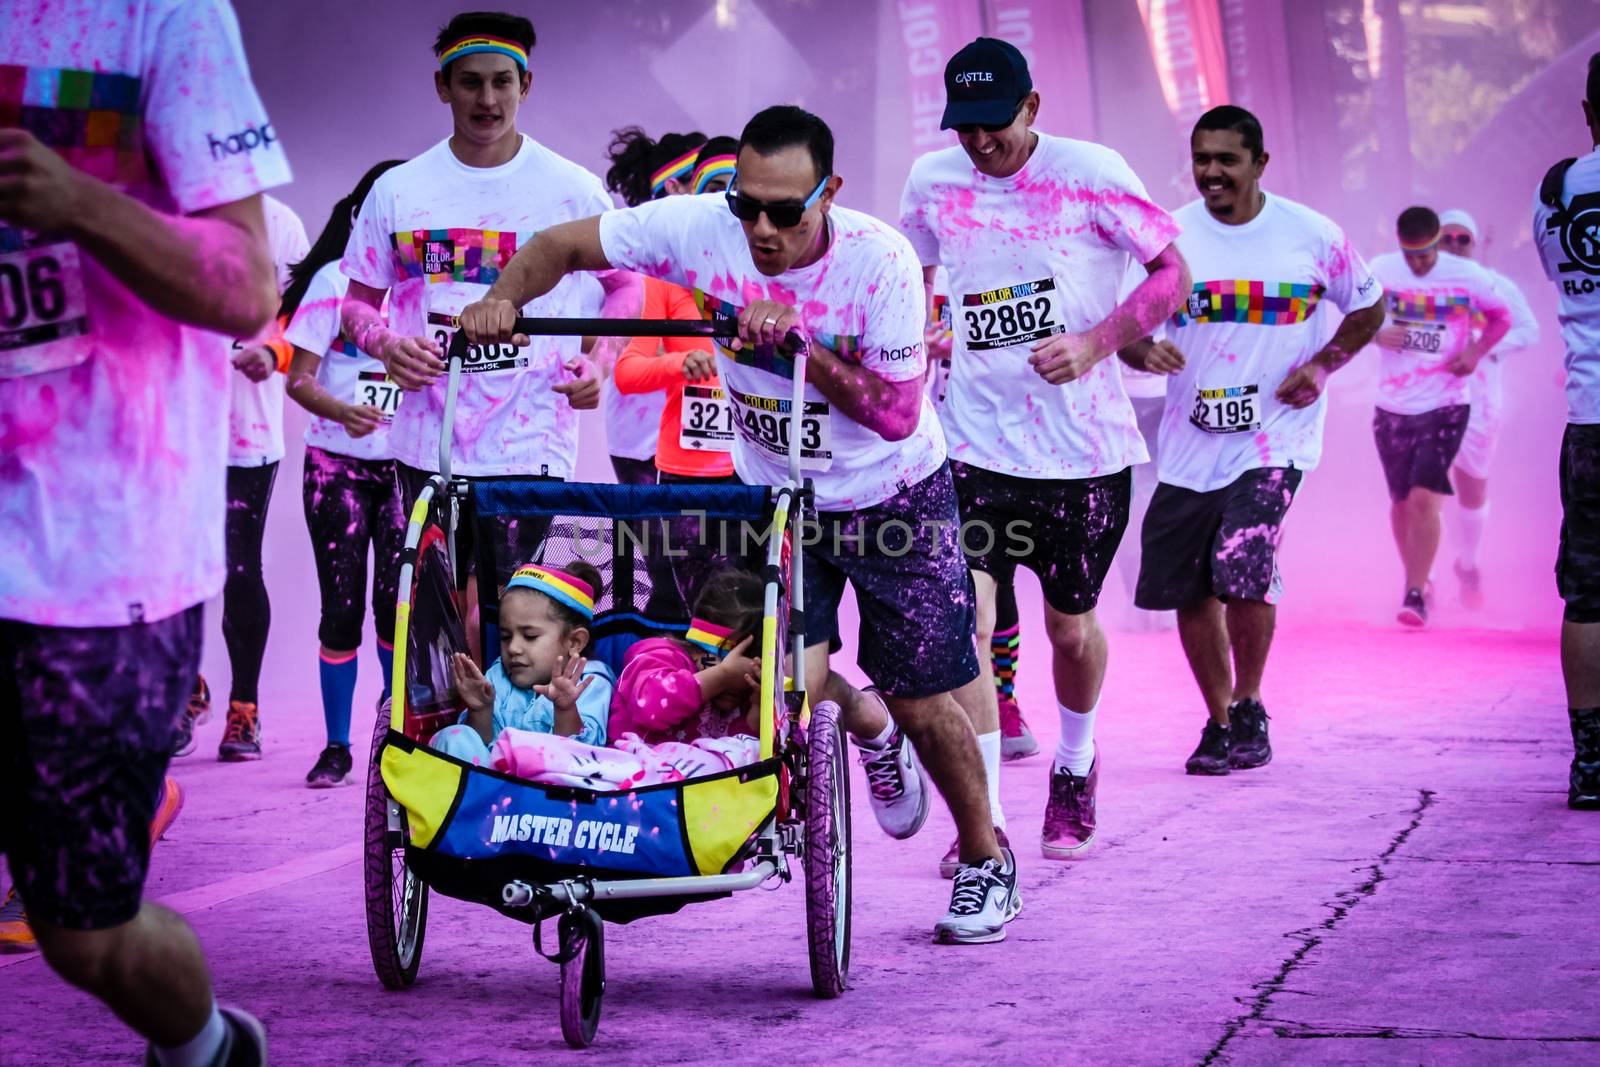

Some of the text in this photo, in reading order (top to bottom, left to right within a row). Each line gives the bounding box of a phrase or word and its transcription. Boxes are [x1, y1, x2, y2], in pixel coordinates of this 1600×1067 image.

[955, 71, 993, 87] CASTLE
[426, 252, 450, 262] COLOR
[981, 283, 1032, 304] COLOR RUN
[965, 297, 1055, 341] 32862
[745, 395, 778, 411] COLOR
[690, 401, 733, 431] 321
[490, 814, 640, 855] MASTER CYCLE
